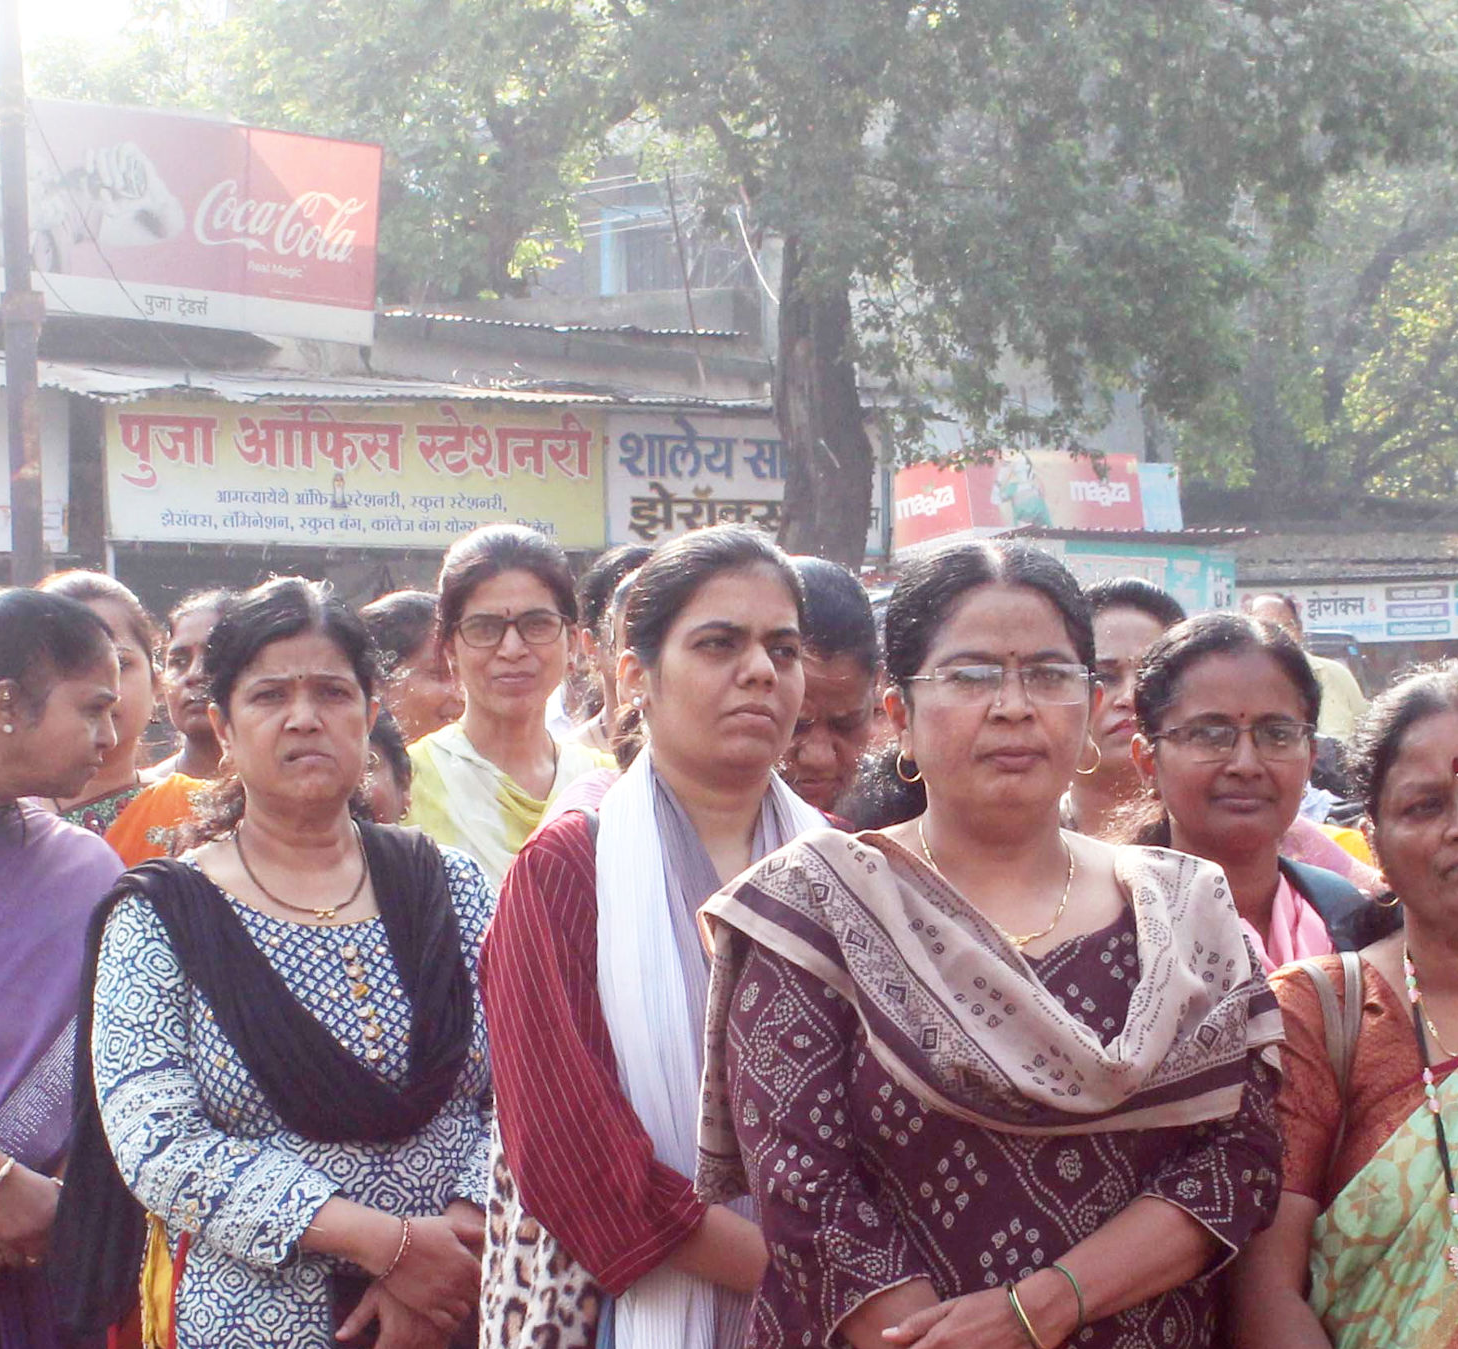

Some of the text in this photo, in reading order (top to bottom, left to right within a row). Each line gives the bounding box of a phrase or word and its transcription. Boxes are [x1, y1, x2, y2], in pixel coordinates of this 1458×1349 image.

[193, 178, 368, 264] Coca-Cola
[246, 259, 271, 275] Real
[177, 295, 209, 318] ट्रेडर्स
[234, 404, 404, 473] ऑफिस
[416, 406, 592, 478] स्टेशनरी
[619, 416, 738, 478] शालेय
[895, 485, 956, 520] maaza
[1070, 479, 1130, 507] maaza
